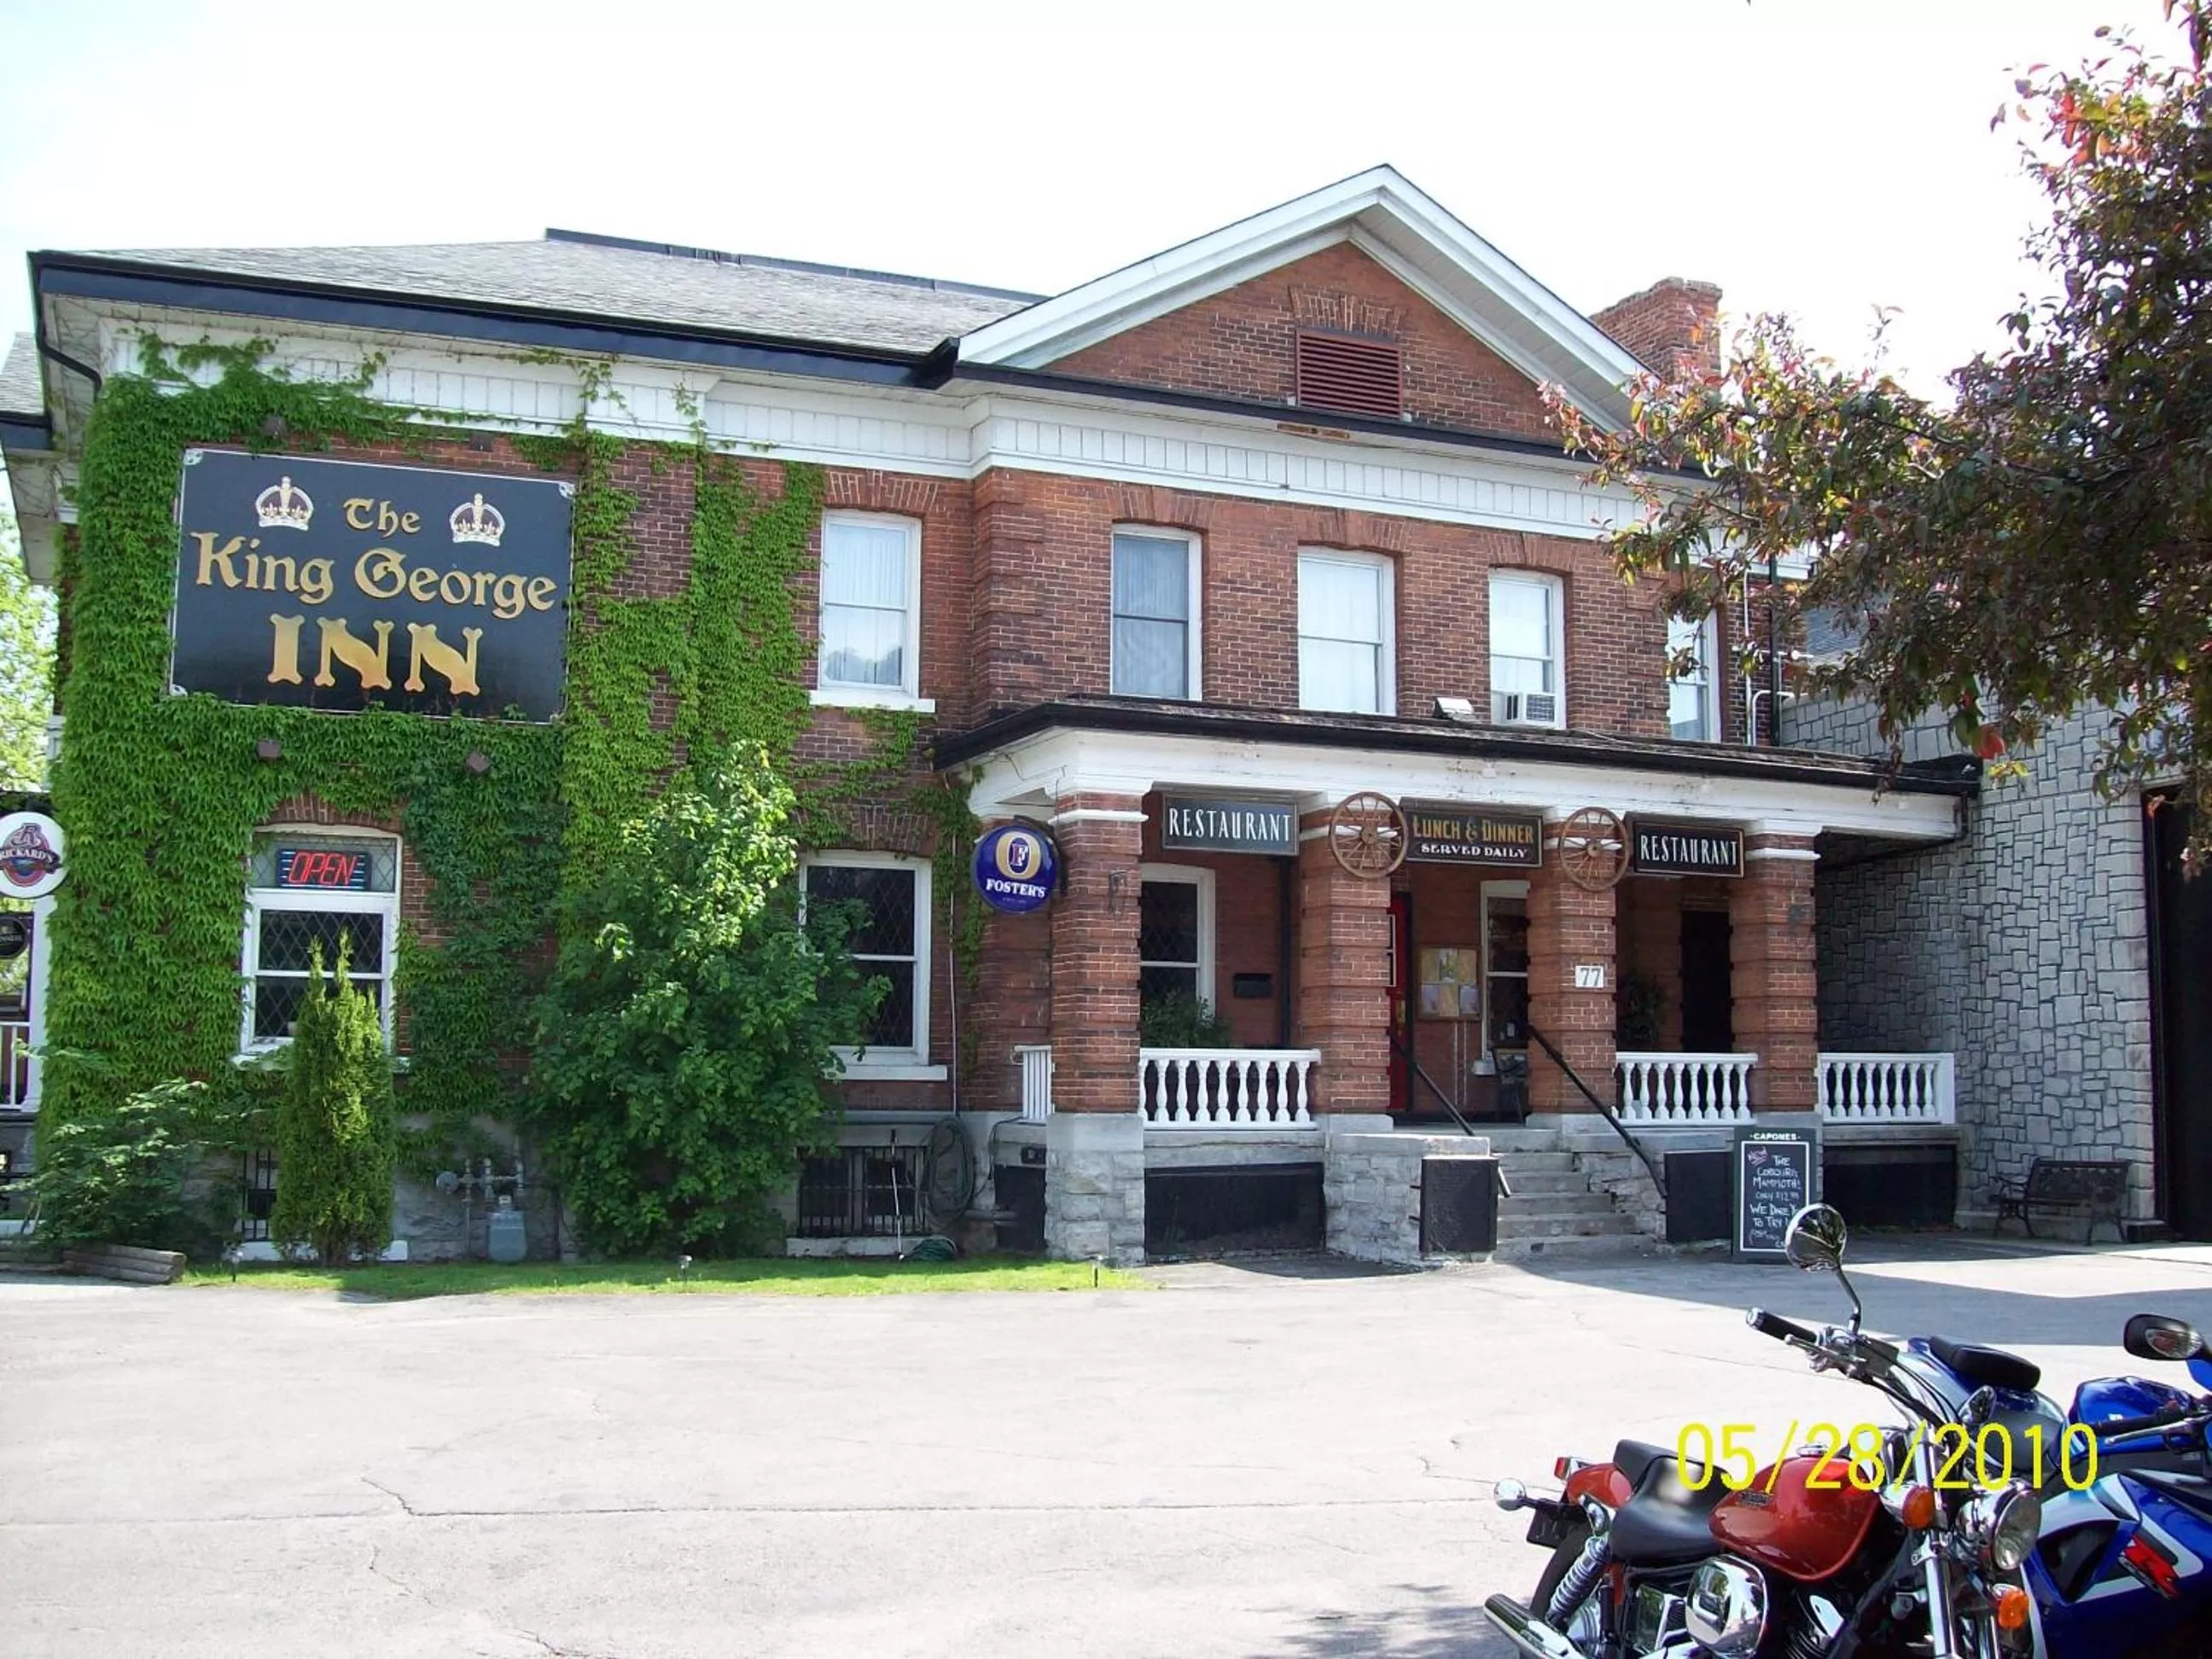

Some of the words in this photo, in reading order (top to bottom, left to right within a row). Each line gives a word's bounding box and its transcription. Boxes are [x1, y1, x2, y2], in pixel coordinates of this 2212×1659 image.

[343, 498, 422, 538] The
[189, 532, 335, 605] King
[354, 547, 558, 620] George
[267, 613, 483, 697] INN
[1168, 807, 1293, 842] RESTAURANT
[1412, 814, 1461, 840] LUNCH
[1465, 821, 1478, 843] &
[1481, 818, 1534, 844] DINNER
[1421, 842, 1480, 856] SERVED
[1484, 847, 1528, 859] DAILY
[1640, 835, 1738, 866] RESTAURANT
[288, 852, 358, 886] OPEN
[986, 878, 1047, 898] FOSTER'S
[1580, 967, 1601, 987] 77
[1749, 1202, 1768, 1214] WE
